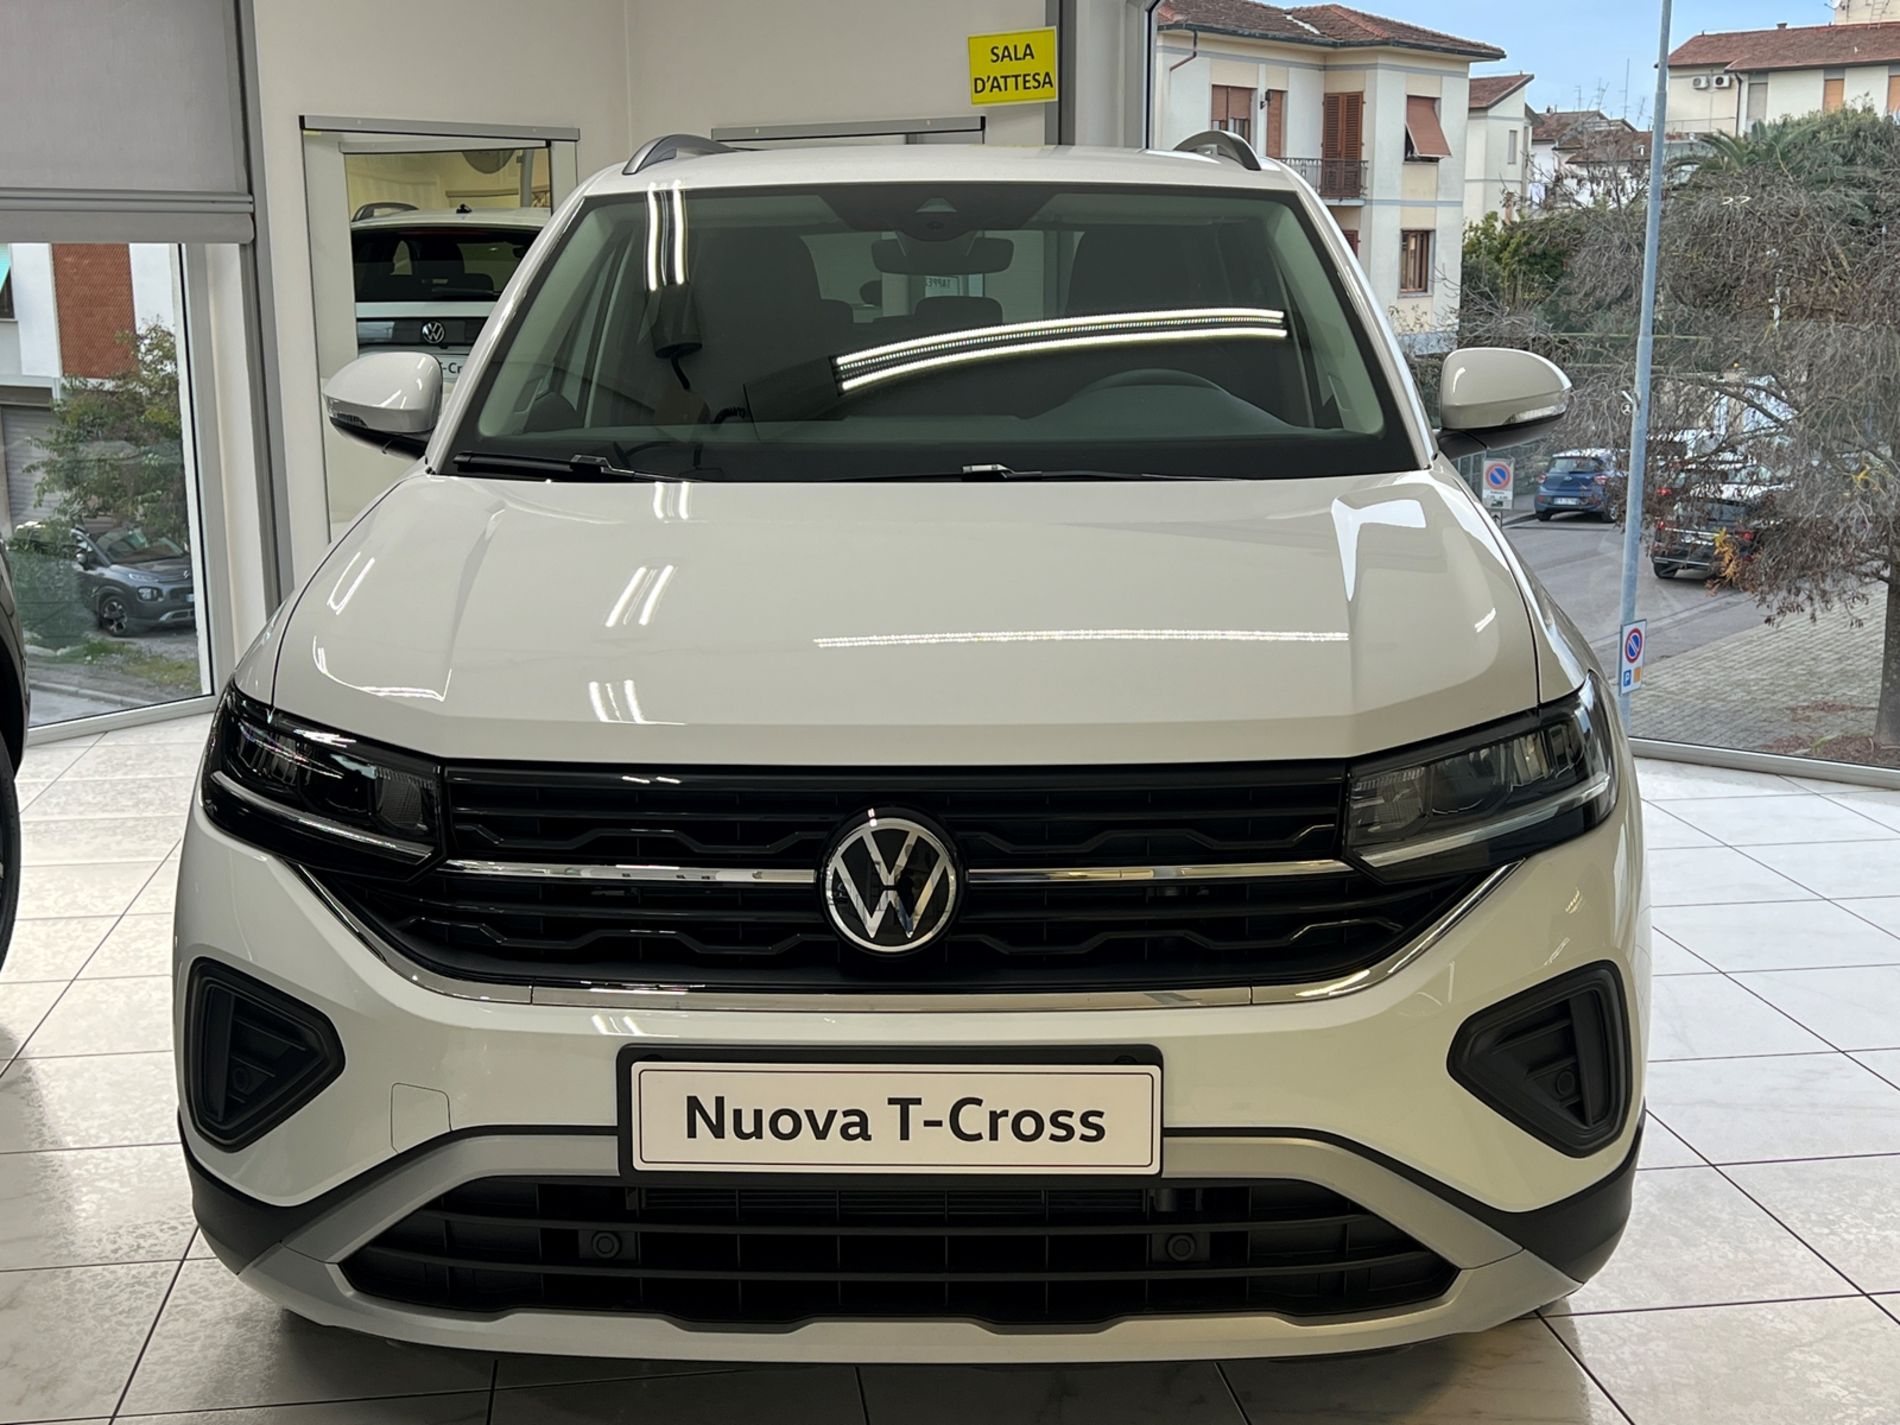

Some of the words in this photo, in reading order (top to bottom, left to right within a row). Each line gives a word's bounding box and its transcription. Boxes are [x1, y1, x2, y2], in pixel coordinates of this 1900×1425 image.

[990, 43, 1035, 63] SALA
[973, 71, 1054, 94] D'ATTESA
[685, 1095, 873, 1142] Nuova
[887, 1096, 1106, 1143] T-Cross
